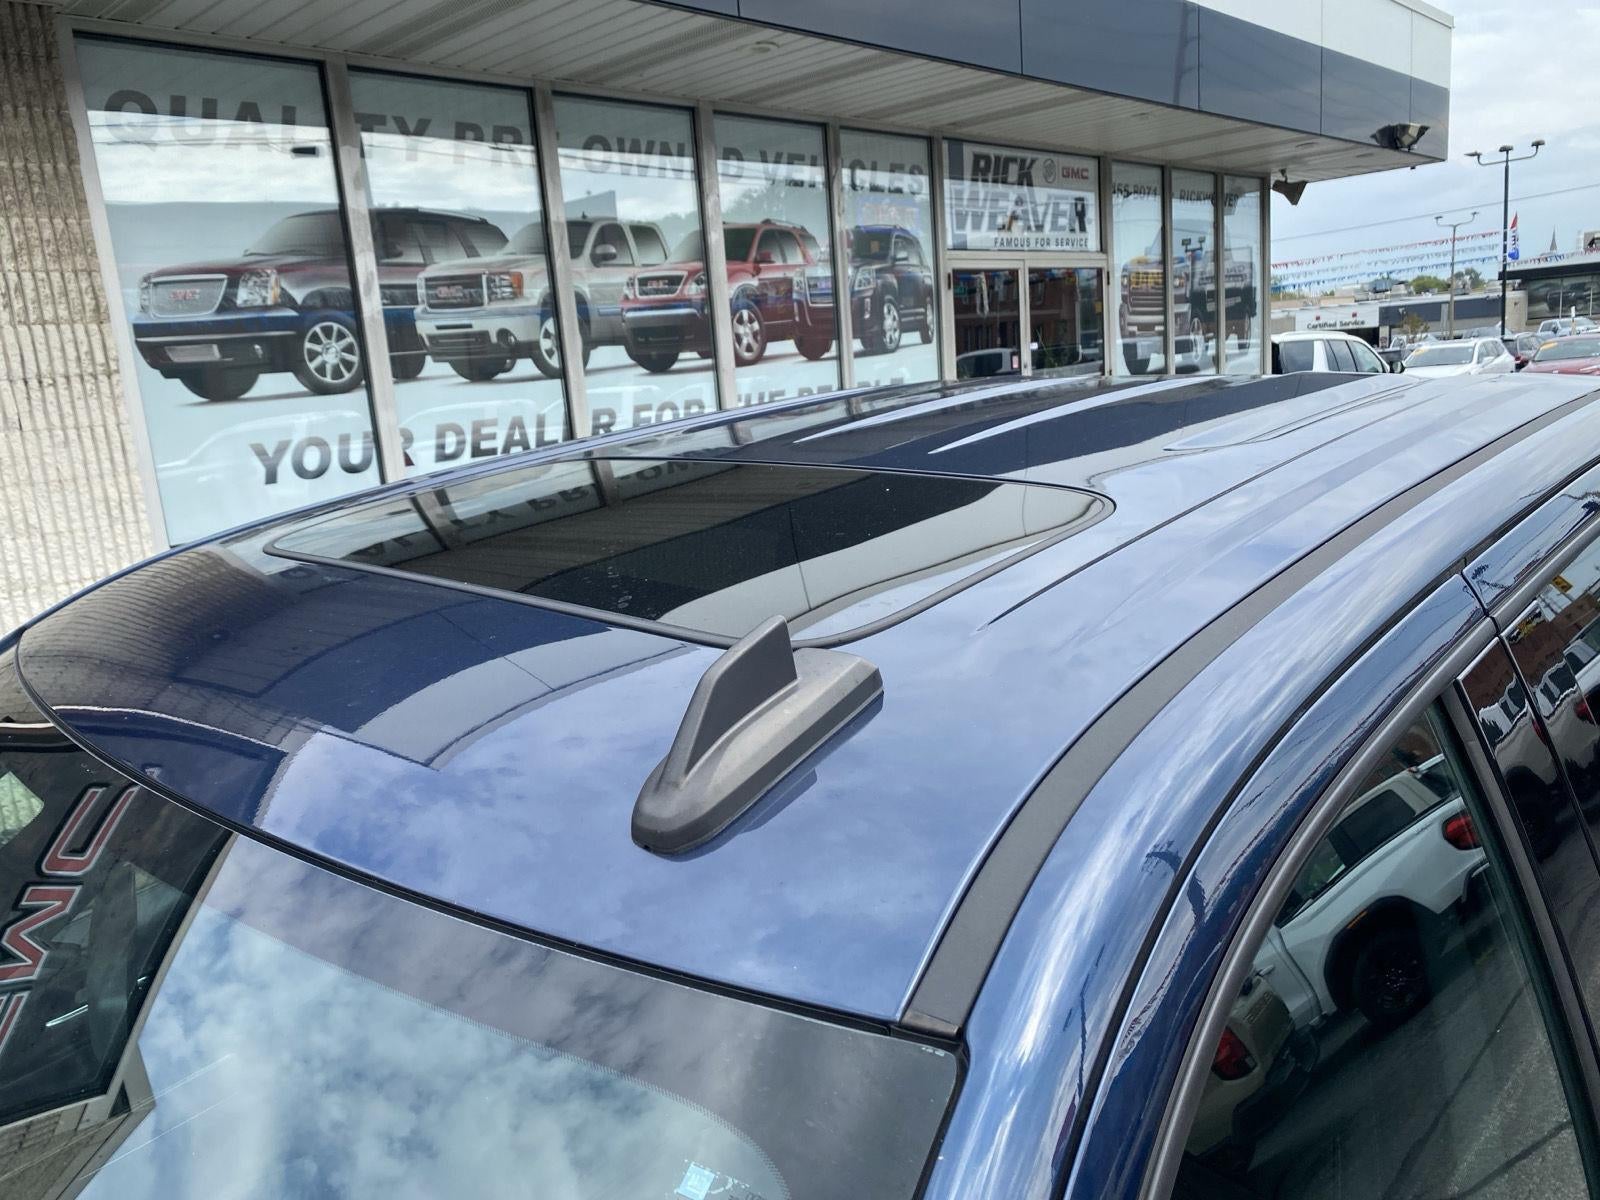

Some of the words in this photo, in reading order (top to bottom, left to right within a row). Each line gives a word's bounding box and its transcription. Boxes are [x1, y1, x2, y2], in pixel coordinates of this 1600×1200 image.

[103, 89, 432, 162] QUALTY
[970, 153, 1038, 187] RICK
[1061, 166, 1089, 180] GMC
[951, 187, 1088, 232] WEAVER
[994, 237, 1031, 247] FAMOUS
[1035, 238, 1051, 247] FOR
[1055, 238, 1088, 248] SERVICE
[1306, 321, 1337, 330] Certified
[1340, 319, 1366, 327] Service
[250, 427, 416, 485] YOUR
